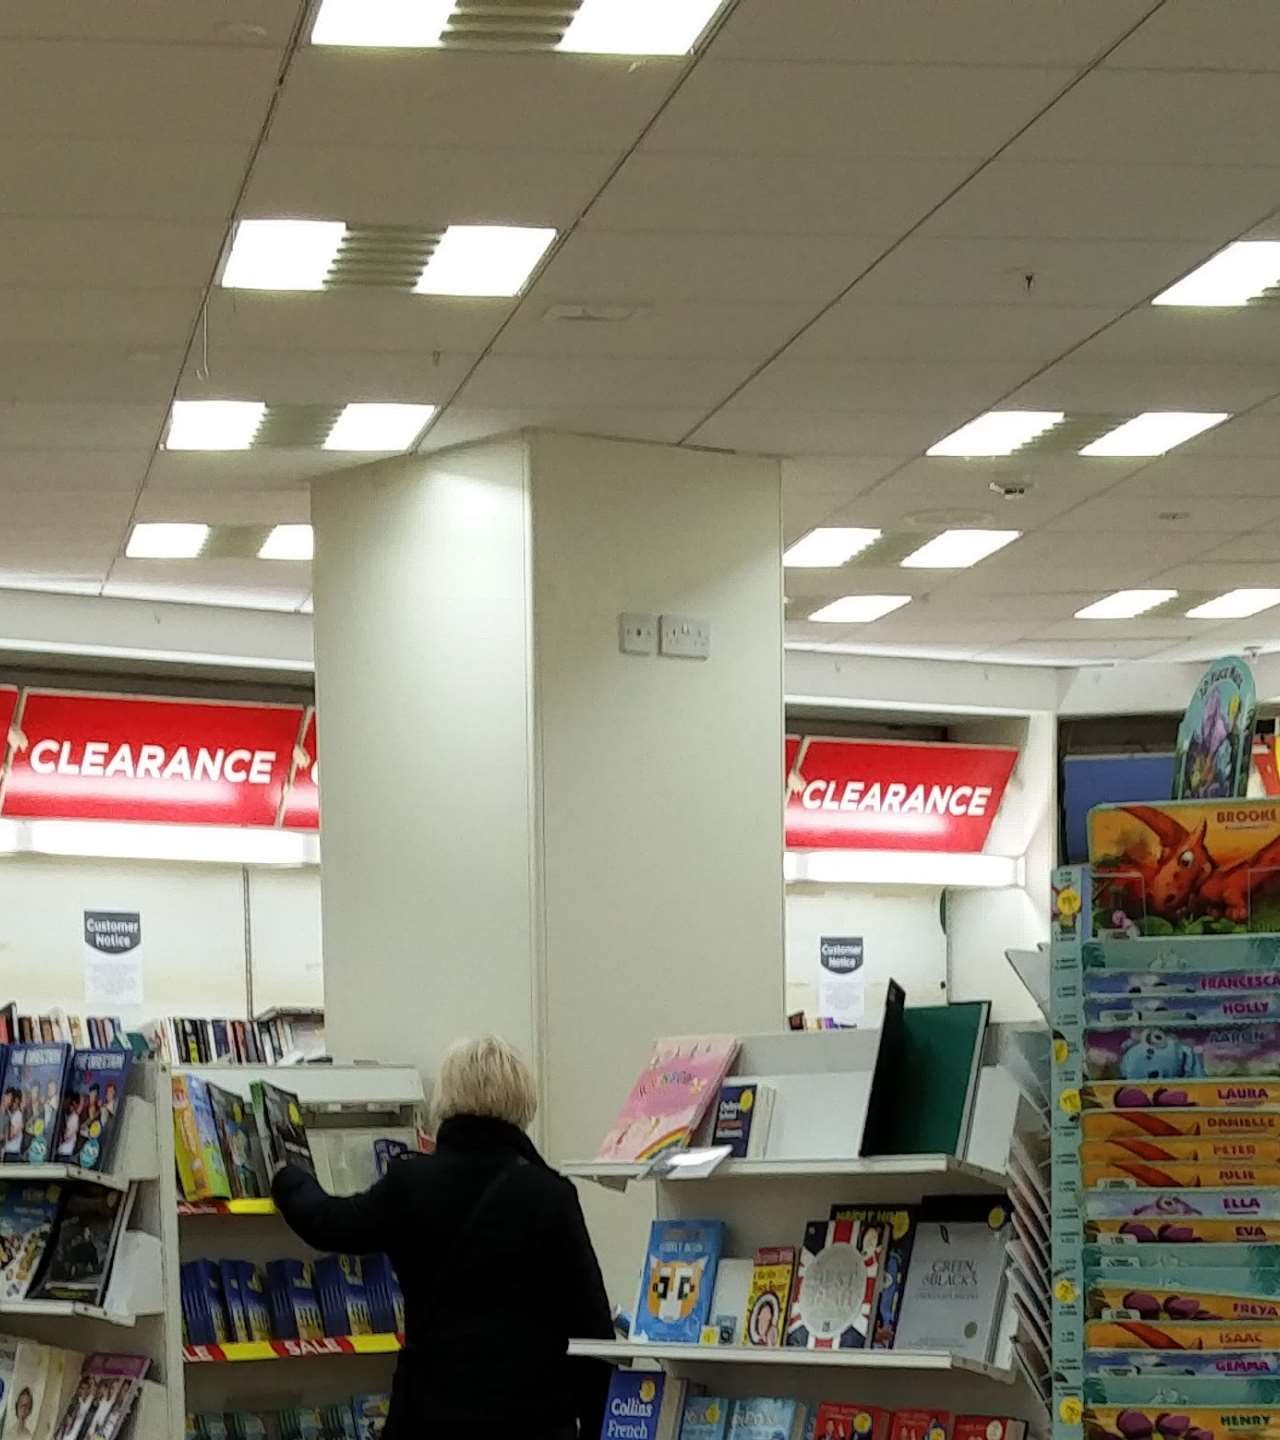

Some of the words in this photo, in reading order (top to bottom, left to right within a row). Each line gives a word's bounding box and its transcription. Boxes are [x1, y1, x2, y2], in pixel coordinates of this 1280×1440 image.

[29, 738, 276, 785] CLEARANCE
[801, 779, 992, 818] CLEARANCE
[1216, 808, 1278, 825] BROOKE
[85, 916, 140, 934] Customer
[94, 932, 132, 948] Notice
[1222, 1001, 1270, 1014] HOLLY
[1217, 1087, 1269, 1100] LAURA
[1207, 1118, 1277, 1128] DANIELLE
[1213, 1144, 1256, 1155] PETER
[1218, 1170, 1256, 1180] JULIE
[1222, 1197, 1260, 1209] ELLA
[1235, 1225, 1266, 1237] EVA
[1232, 1302, 1279, 1316] FREYA
[1219, 1332, 1264, 1344] ISAAC
[184, 1344, 213, 1362] LE
[284, 1338, 342, 1356] SALE
[1215, 1360, 1271, 1373] GEMMA
[610, 1397, 653, 1417] Collins
[1220, 1415, 1271, 1427] HENRY
[607, 1419, 648, 1440] French
